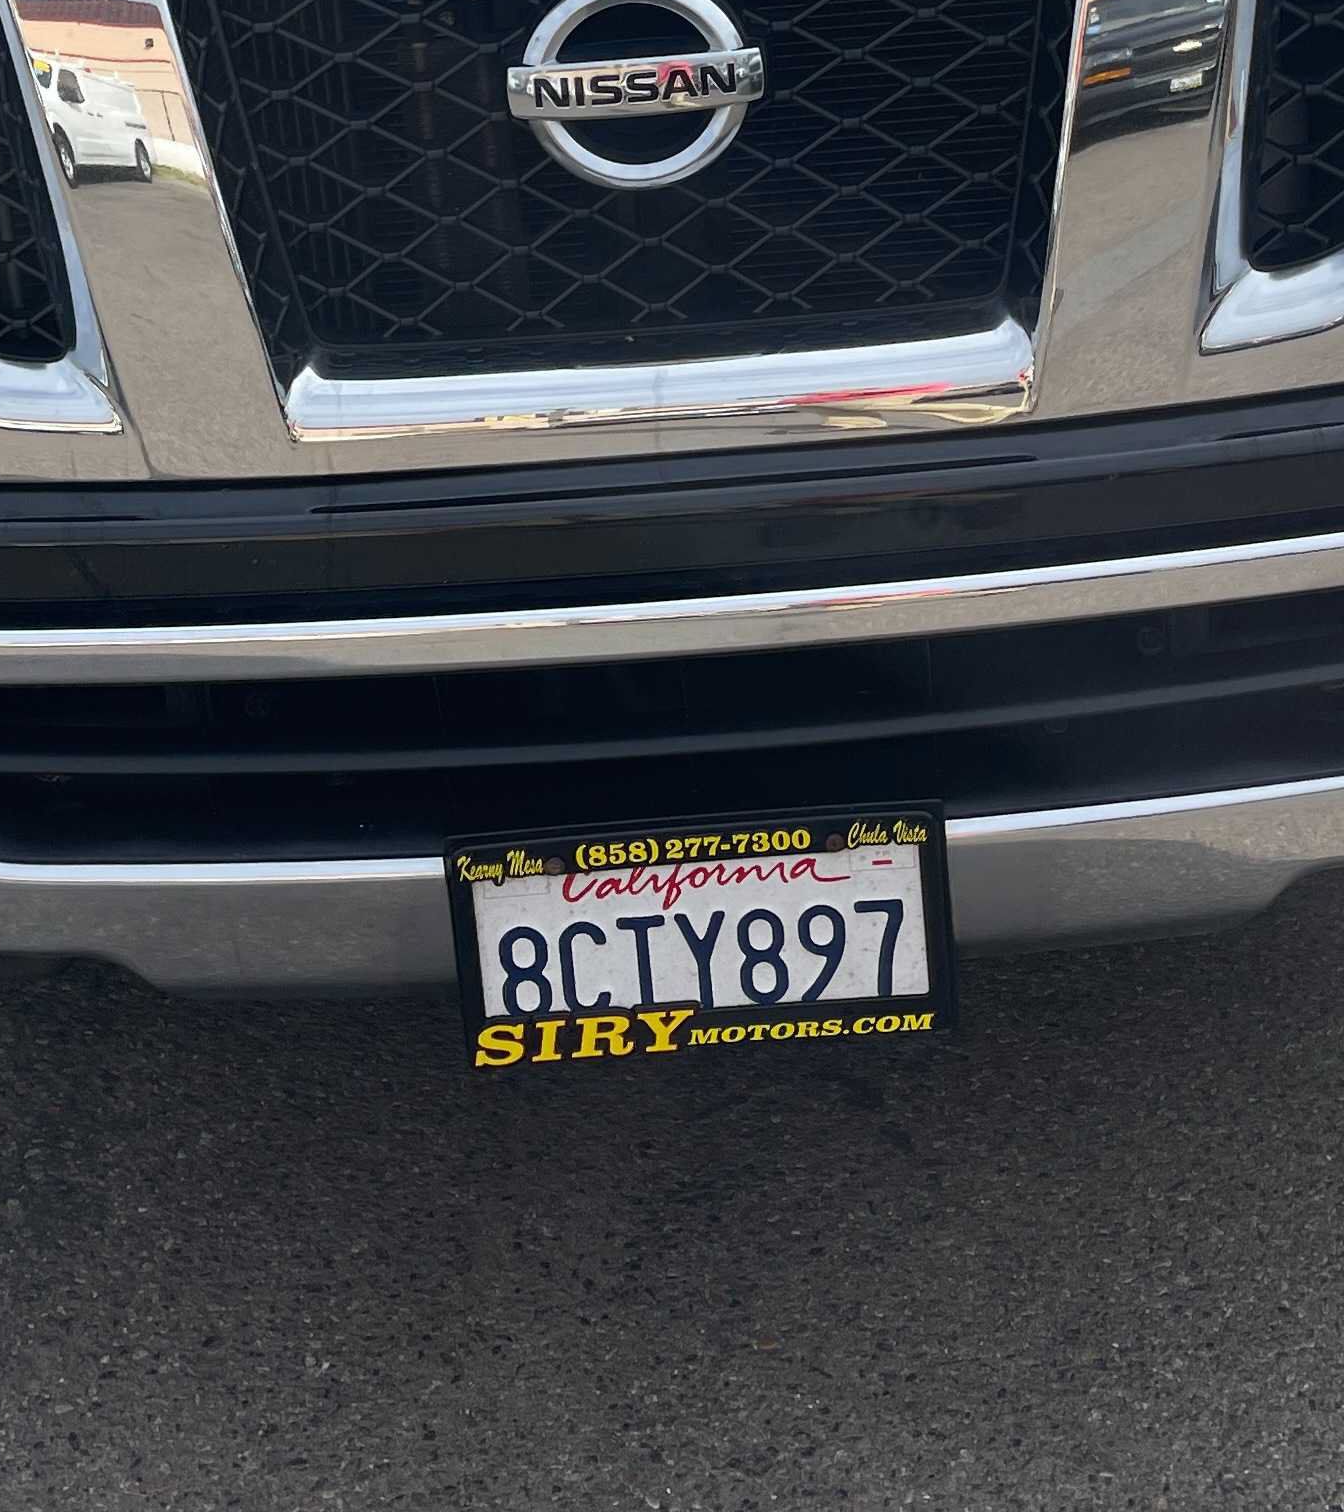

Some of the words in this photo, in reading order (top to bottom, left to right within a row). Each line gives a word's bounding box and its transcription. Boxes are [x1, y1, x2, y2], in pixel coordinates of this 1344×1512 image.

[532, 62, 738, 109] NISSAN
[456, 855, 504, 883] Kearny
[506, 848, 544, 877] Mesa
[575, 838, 660, 870] (858)
[665, 828, 812, 860] 277-7300
[847, 821, 889, 849] Chula
[892, 819, 929, 845] Vista
[562, 856, 852, 911] California
[498, 898, 904, 1016] 8CTY897
